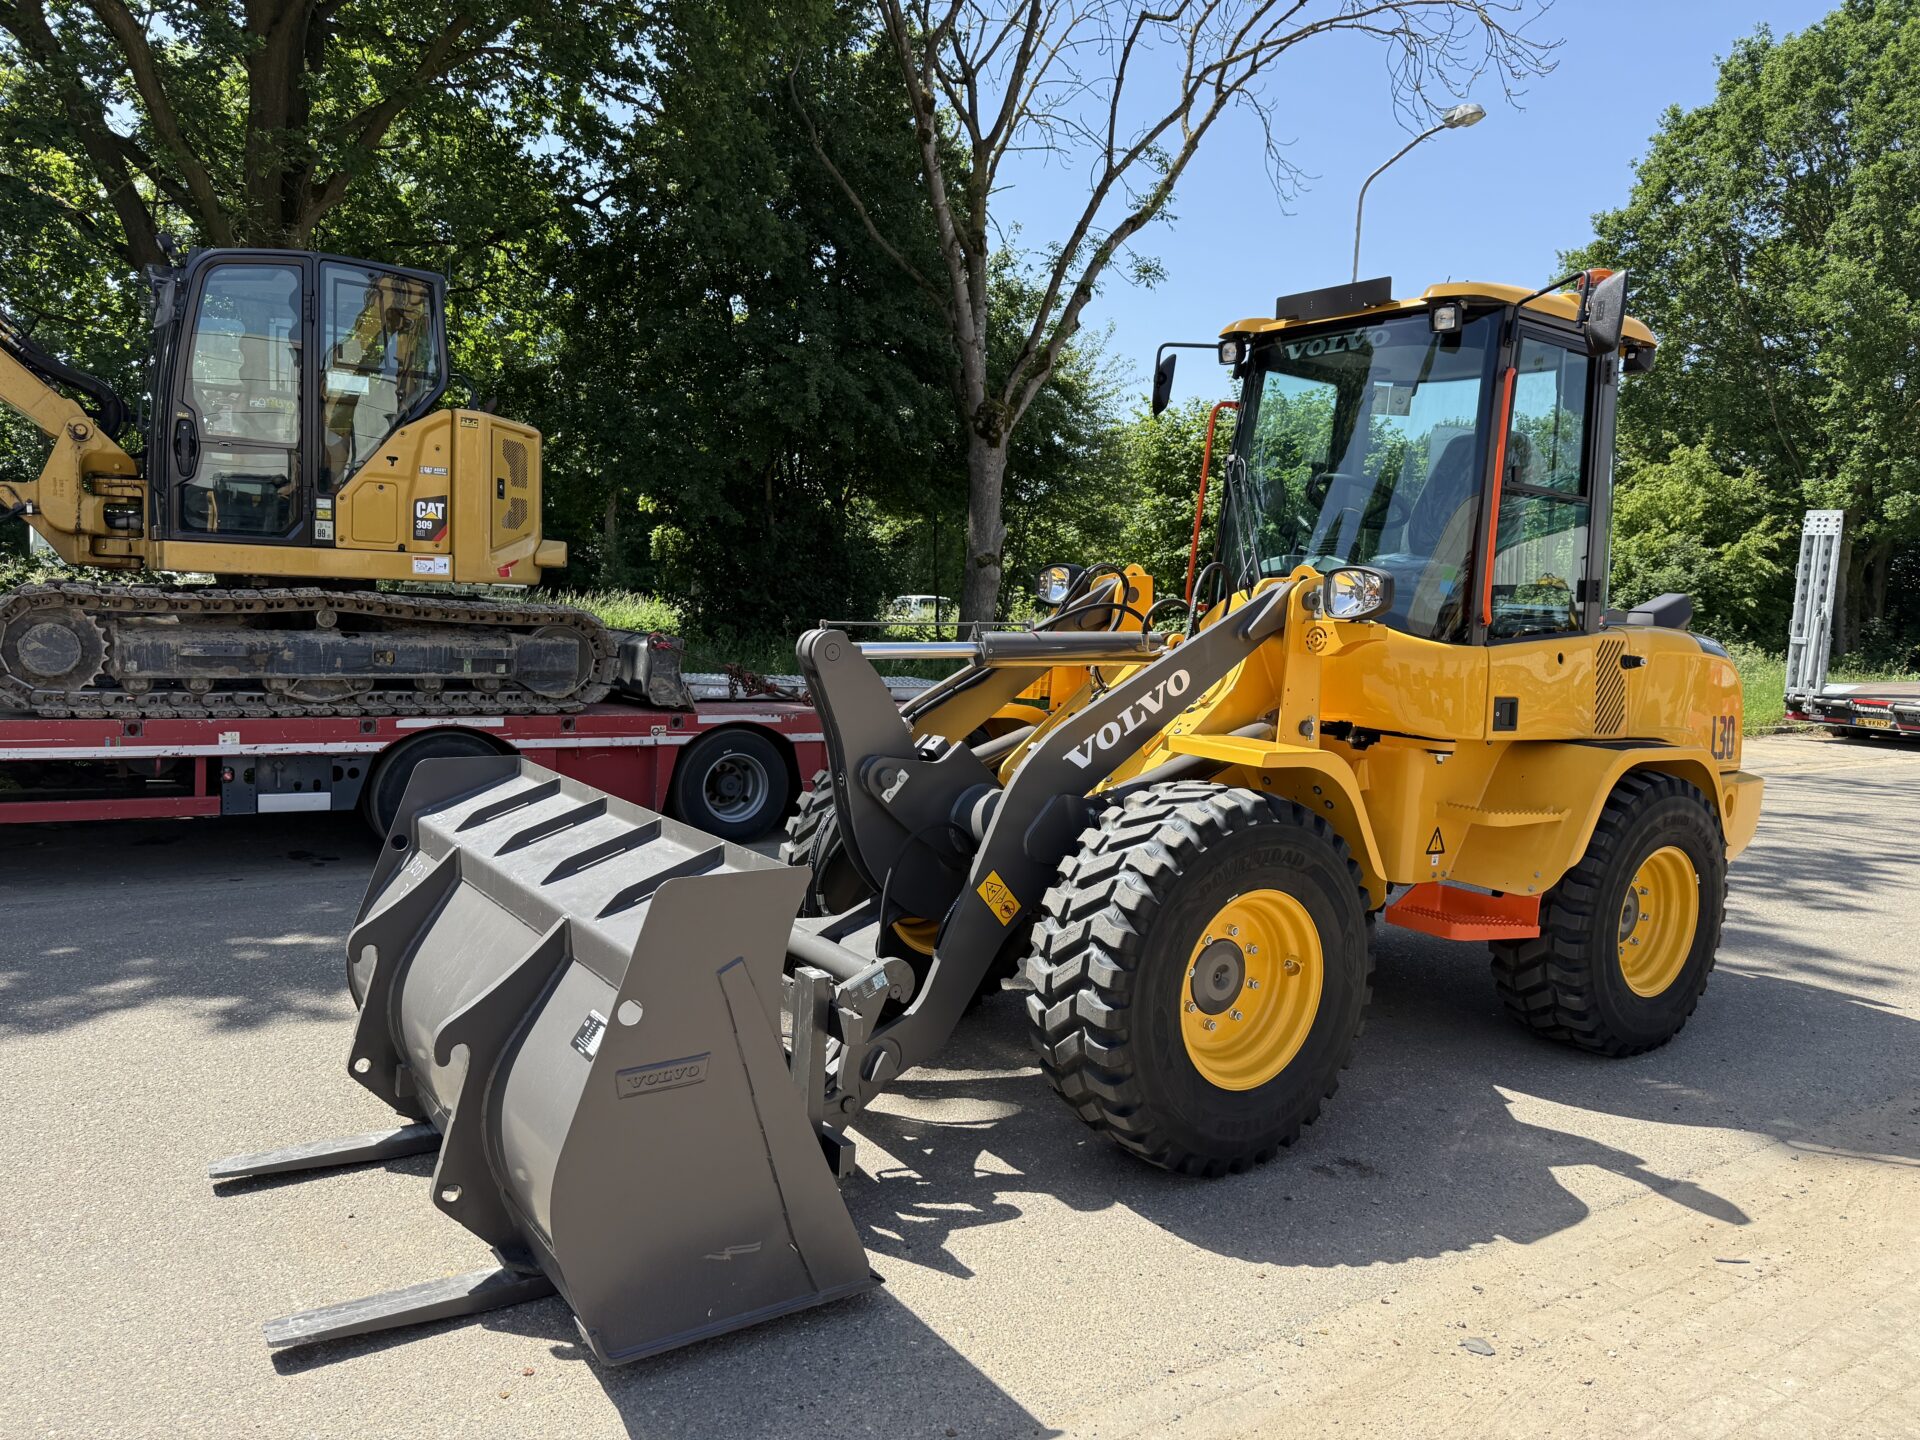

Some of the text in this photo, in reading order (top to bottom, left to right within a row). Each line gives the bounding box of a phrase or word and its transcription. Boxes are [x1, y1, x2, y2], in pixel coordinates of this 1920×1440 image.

[1285, 326, 1392, 360] VOLVO
[416, 501, 445, 519] CAT
[416, 520, 432, 530] 309
[1062, 669, 1191, 769] VOLVO
[1711, 715, 1736, 760] L30
[626, 1064, 700, 1089] VOLVO
